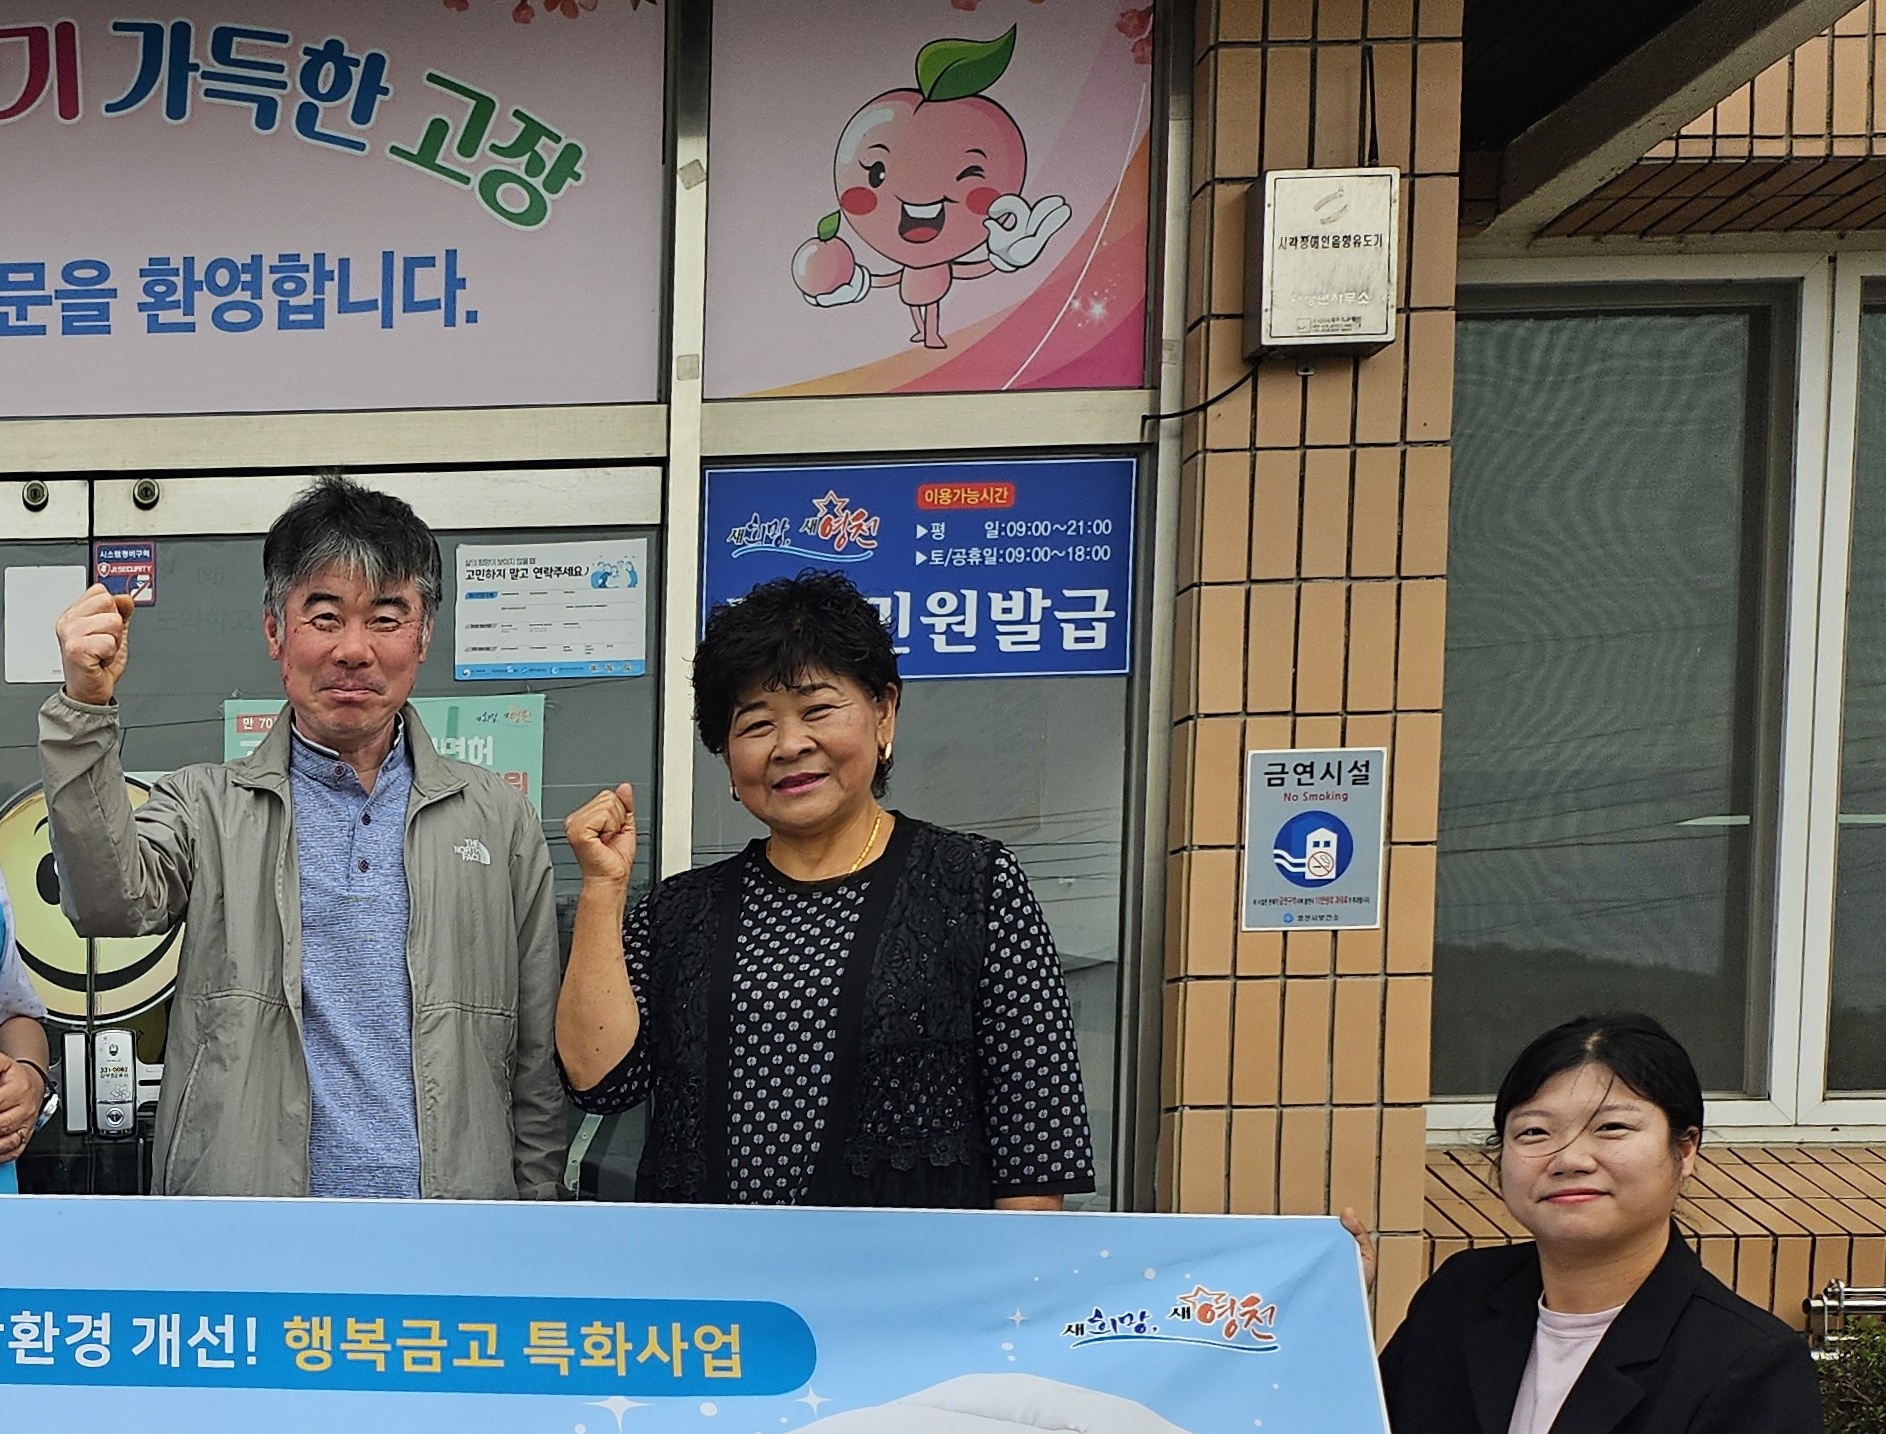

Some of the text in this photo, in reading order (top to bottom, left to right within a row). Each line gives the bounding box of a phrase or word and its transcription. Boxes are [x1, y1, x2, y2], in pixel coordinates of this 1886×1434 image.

[104, 20, 390, 151] 가득한
[389, 70, 586, 228] 고장
[137, 249, 478, 333] 환영합니다.
[925, 487, 1008, 505] 이용가능시간
[465, 568, 506, 581] 고민하지
[509, 568, 529, 580] 말고
[432, 735, 494, 766] 면허
[1263, 760, 1371, 788] 금연시설
[1283, 791, 1349, 803] No Smoking
[131, 1312, 258, 1368] 개선!
[282, 1315, 504, 1374] 행복금고
[522, 1319, 744, 1379] 특화사업
